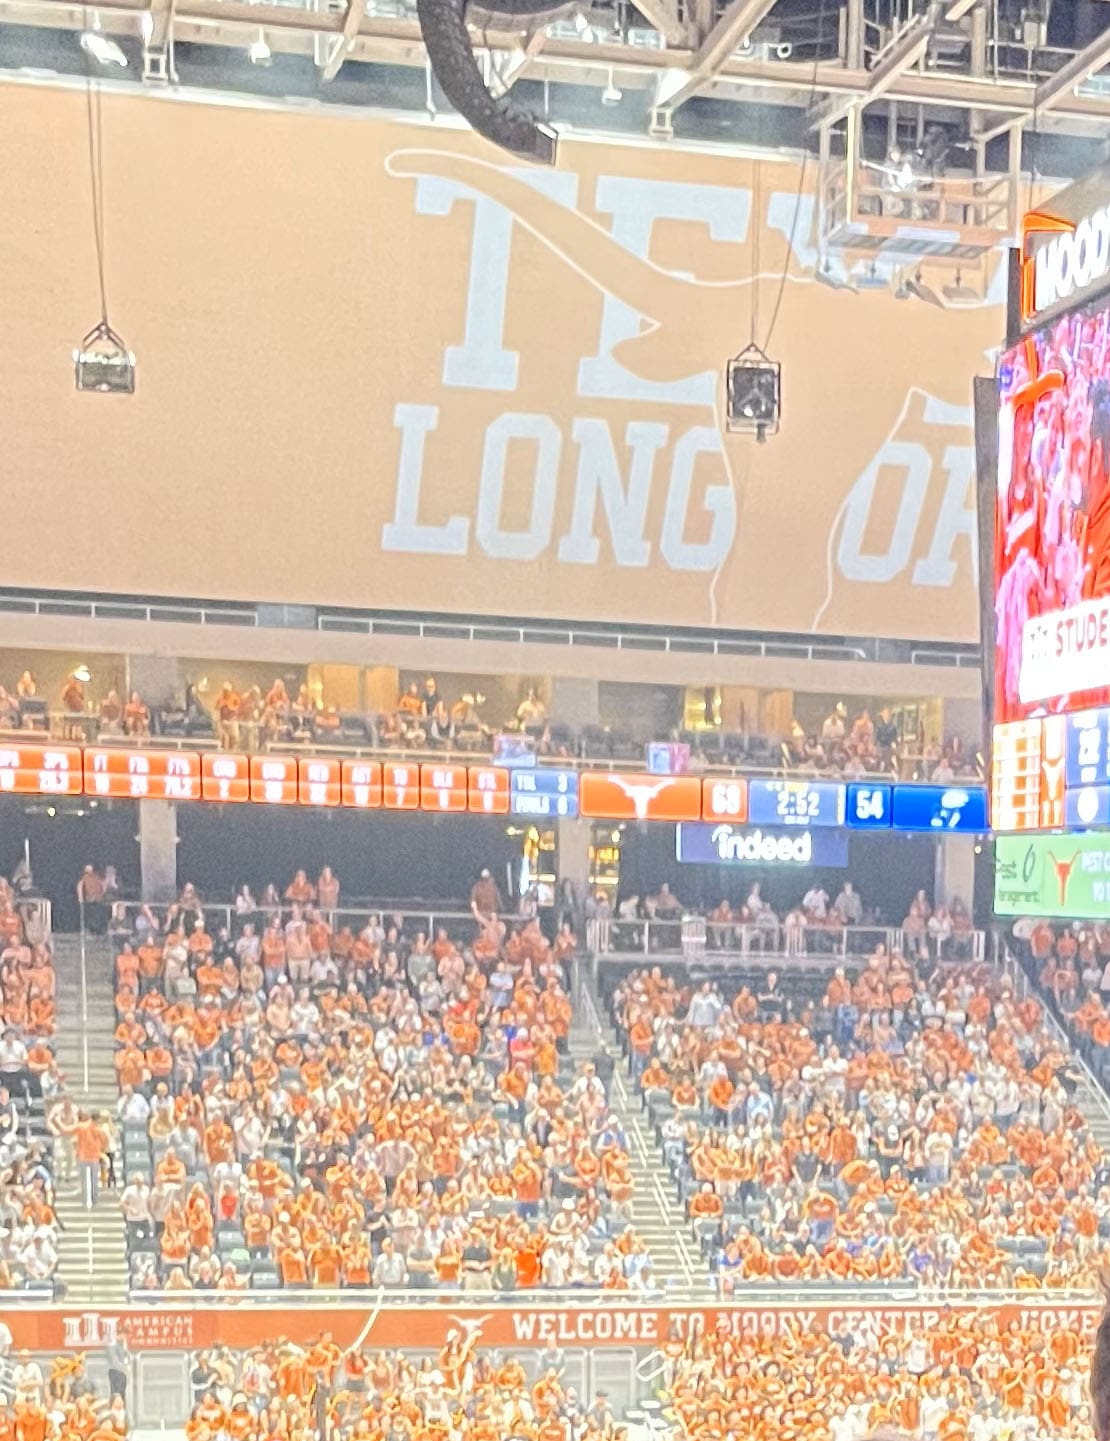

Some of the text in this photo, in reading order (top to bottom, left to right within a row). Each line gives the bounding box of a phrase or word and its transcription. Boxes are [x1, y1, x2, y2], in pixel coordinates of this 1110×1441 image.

[776, 791, 820, 817] 2:52
[856, 790, 884, 819] 54
[711, 824, 812, 862] indeed
[124, 1315, 193, 1327] AMERICAN
[127, 1327, 193, 1338] AMPUS
[511, 1312, 659, 1340] WELCOME
